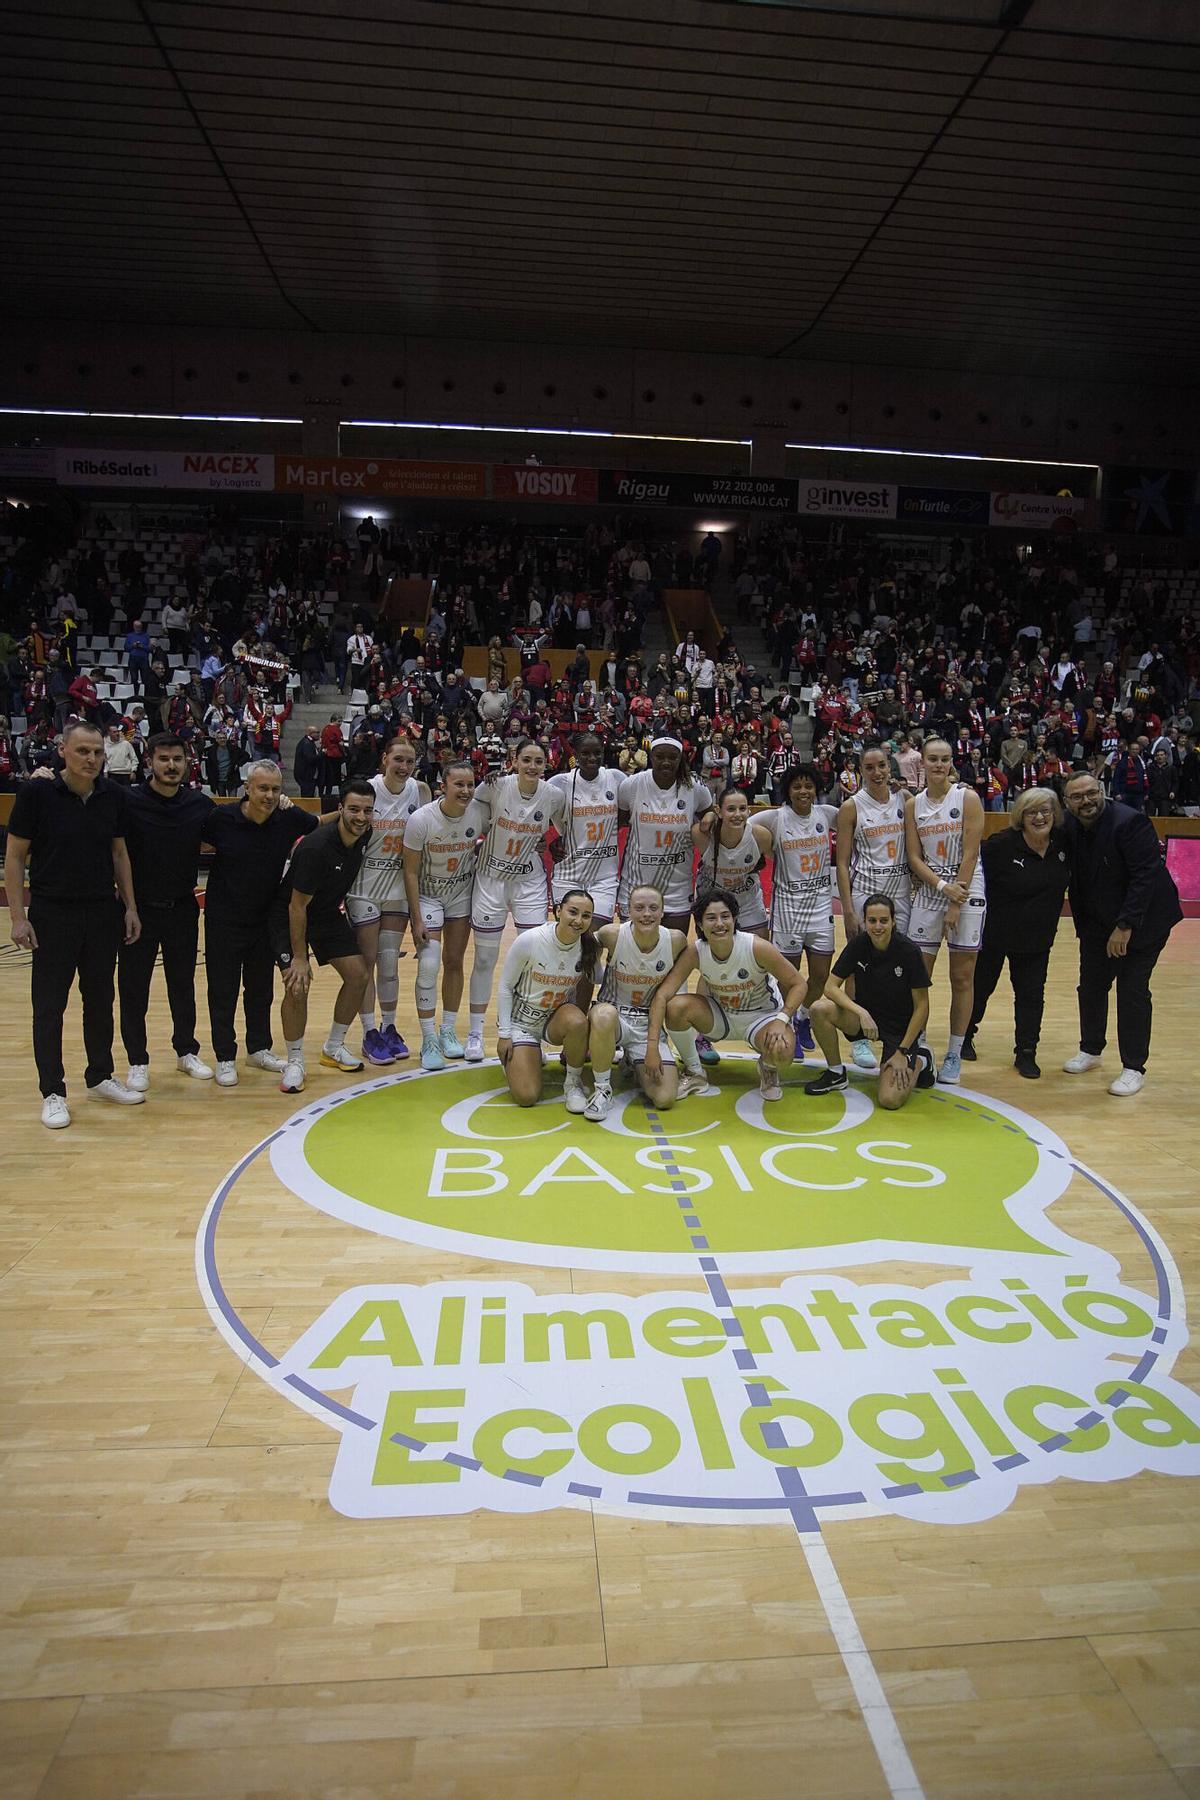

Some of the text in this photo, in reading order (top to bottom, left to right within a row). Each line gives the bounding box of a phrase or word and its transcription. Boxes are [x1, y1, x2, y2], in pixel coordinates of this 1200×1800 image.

[73, 461, 152, 477] RibéSalat
[184, 455, 260, 474] NACEX
[209, 477, 222, 488] by
[286, 464, 366, 488] Marlex
[617, 479, 671, 500] Rigau
[712, 480, 776, 493] 972 202 004
[693, 491, 790, 508] WWW.RIGAU.CAT
[806, 487, 890, 511] ginvest
[903, 497, 951, 512] OnTurtle
[1021, 503, 1050, 514] Centre
[864, 822, 905, 838] GIRON
[575, 849, 608, 857] SPAR
[936, 840, 947, 859] 4
[367, 860, 401, 868] SPAR
[490, 859, 523, 873] SPAR
[641, 856, 675, 864] SPAR
[800, 853, 819, 873] 23
[934, 867, 960, 877] PAR
[792, 879, 823, 891] SPAR
[427, 1141, 947, 1198] BASICS
[308, 1274, 1155, 1369] Alimentació
[371, 1368, 1200, 1493] Ecològica
